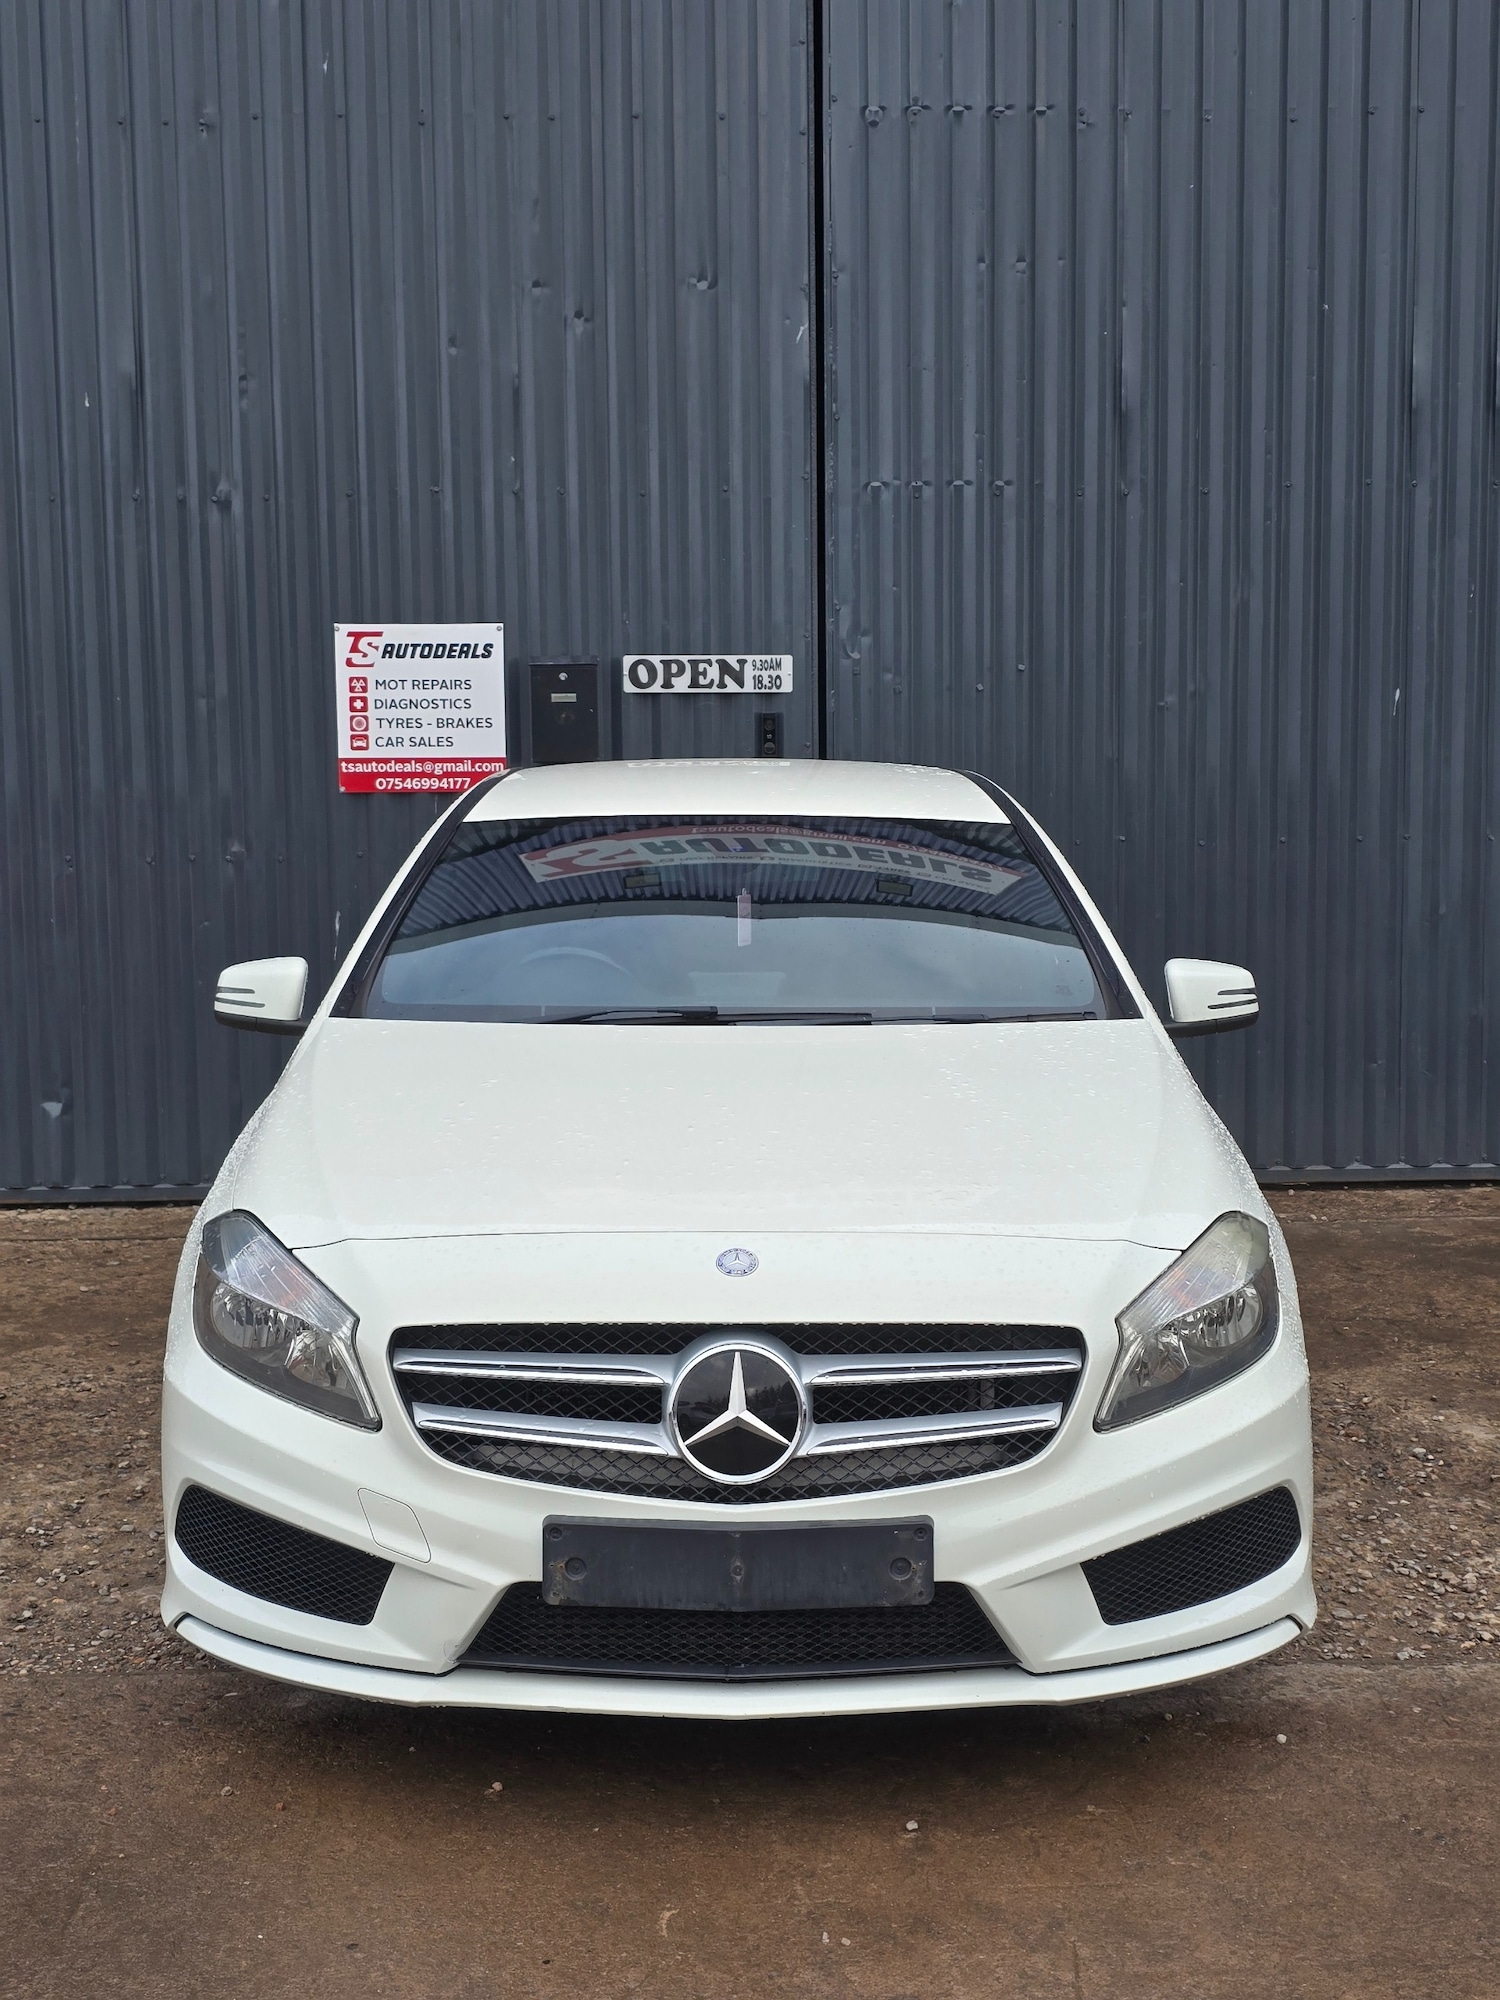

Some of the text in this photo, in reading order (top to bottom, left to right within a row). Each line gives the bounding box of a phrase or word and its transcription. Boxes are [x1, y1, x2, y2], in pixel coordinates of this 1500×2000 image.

[381, 643, 494, 659] AUTODEALS
[751, 657, 782, 672] 9.30AM
[628, 658, 748, 690] OPEN
[375, 679, 472, 690] MOT REPAIRS
[752, 674, 782, 690] 18.30
[374, 698, 472, 710] DIAGNOSTICS
[376, 717, 423, 729] TYRES
[436, 717, 493, 729] BRAKES
[375, 736, 454, 748] CAR SALES
[341, 760, 504, 775] tsautodeals@gmail.com
[375, 777, 471, 790] 07546994177
